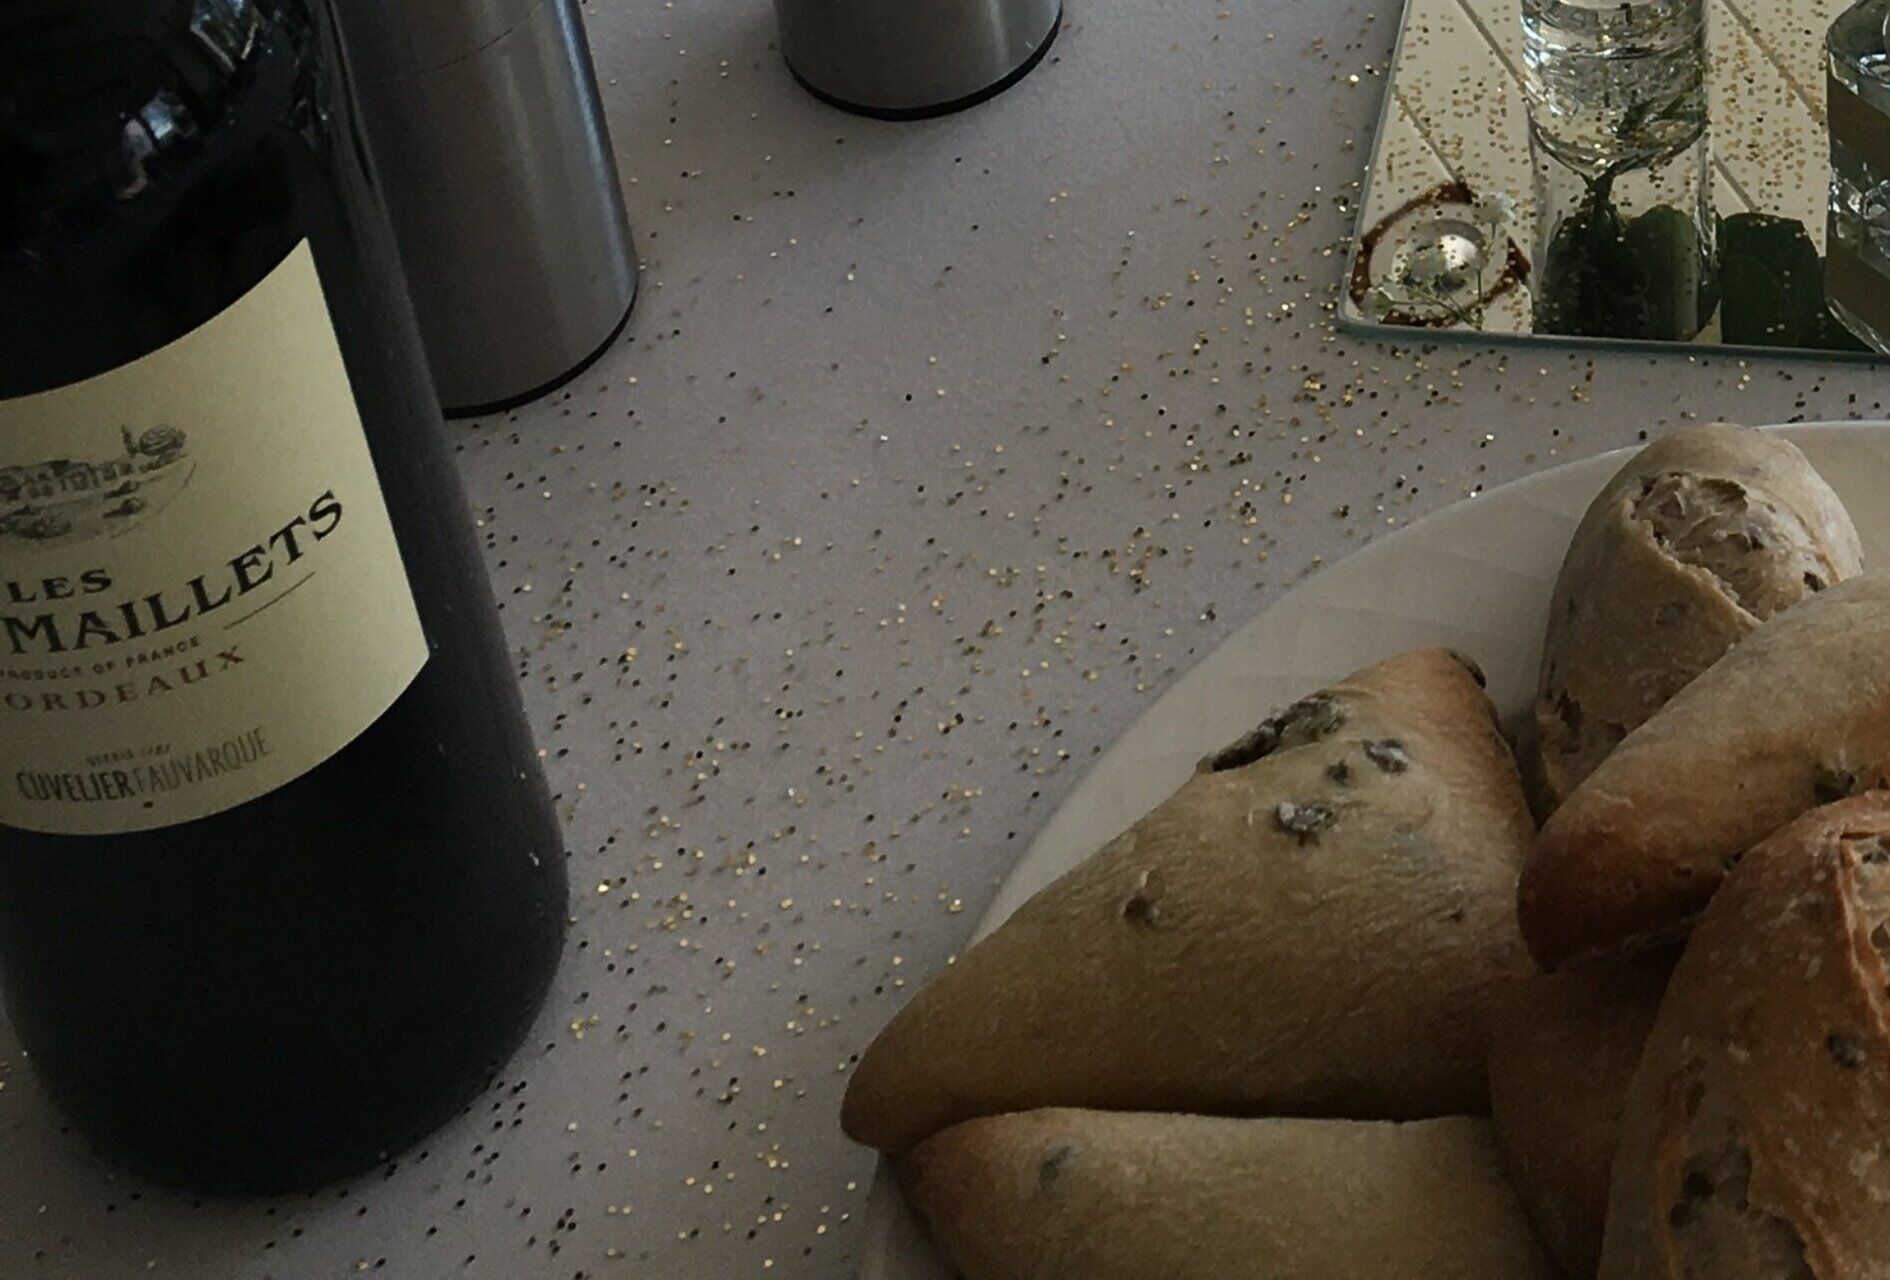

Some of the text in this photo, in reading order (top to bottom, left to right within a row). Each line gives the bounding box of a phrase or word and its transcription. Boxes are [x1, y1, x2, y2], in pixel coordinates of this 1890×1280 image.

[1, 490, 343, 654] MAILLETS
[6, 568, 112, 603] LES
[5, 645, 244, 712] ORDEAUX
[92, 660, 115, 675] OF
[126, 634, 201, 669] FRANCE
